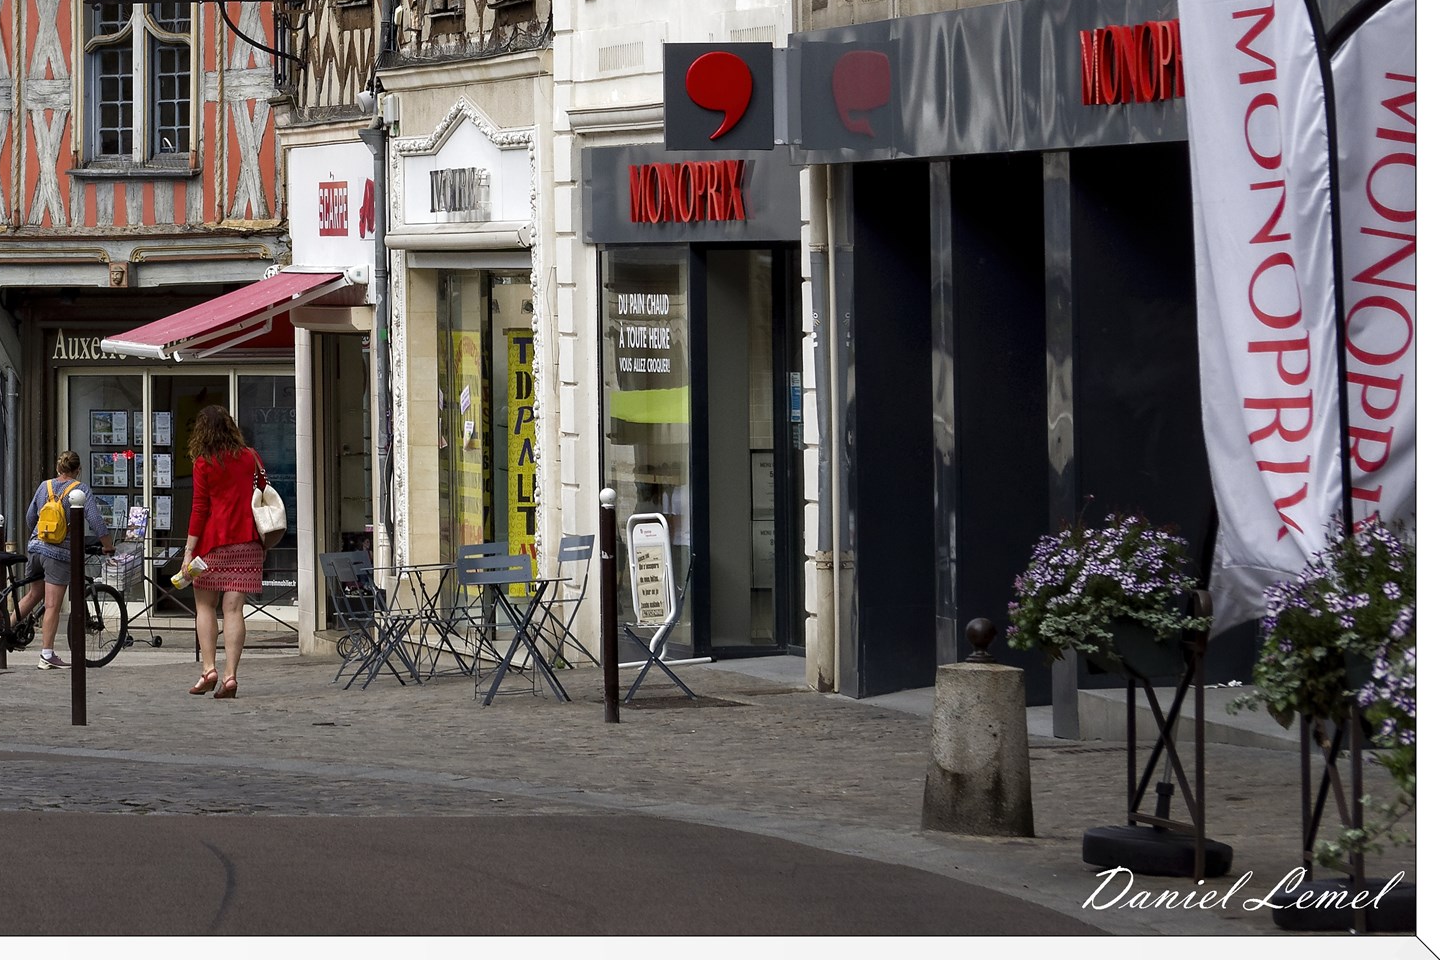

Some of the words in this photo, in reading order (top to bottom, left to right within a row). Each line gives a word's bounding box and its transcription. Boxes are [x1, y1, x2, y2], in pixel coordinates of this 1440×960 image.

[1079, 18, 1185, 106] MONOP
[628, 159, 745, 224] MONOPRIX
[618, 294, 628, 315] DU
[629, 293, 645, 315] PAIN
[646, 294, 669, 315] CHAUD
[619, 321, 625, 348] À
[627, 326, 647, 348] TOUTE
[649, 327, 670, 349] HEURE
[619, 357, 632, 372] VOUS
[633, 358, 646, 372] ALLEZ
